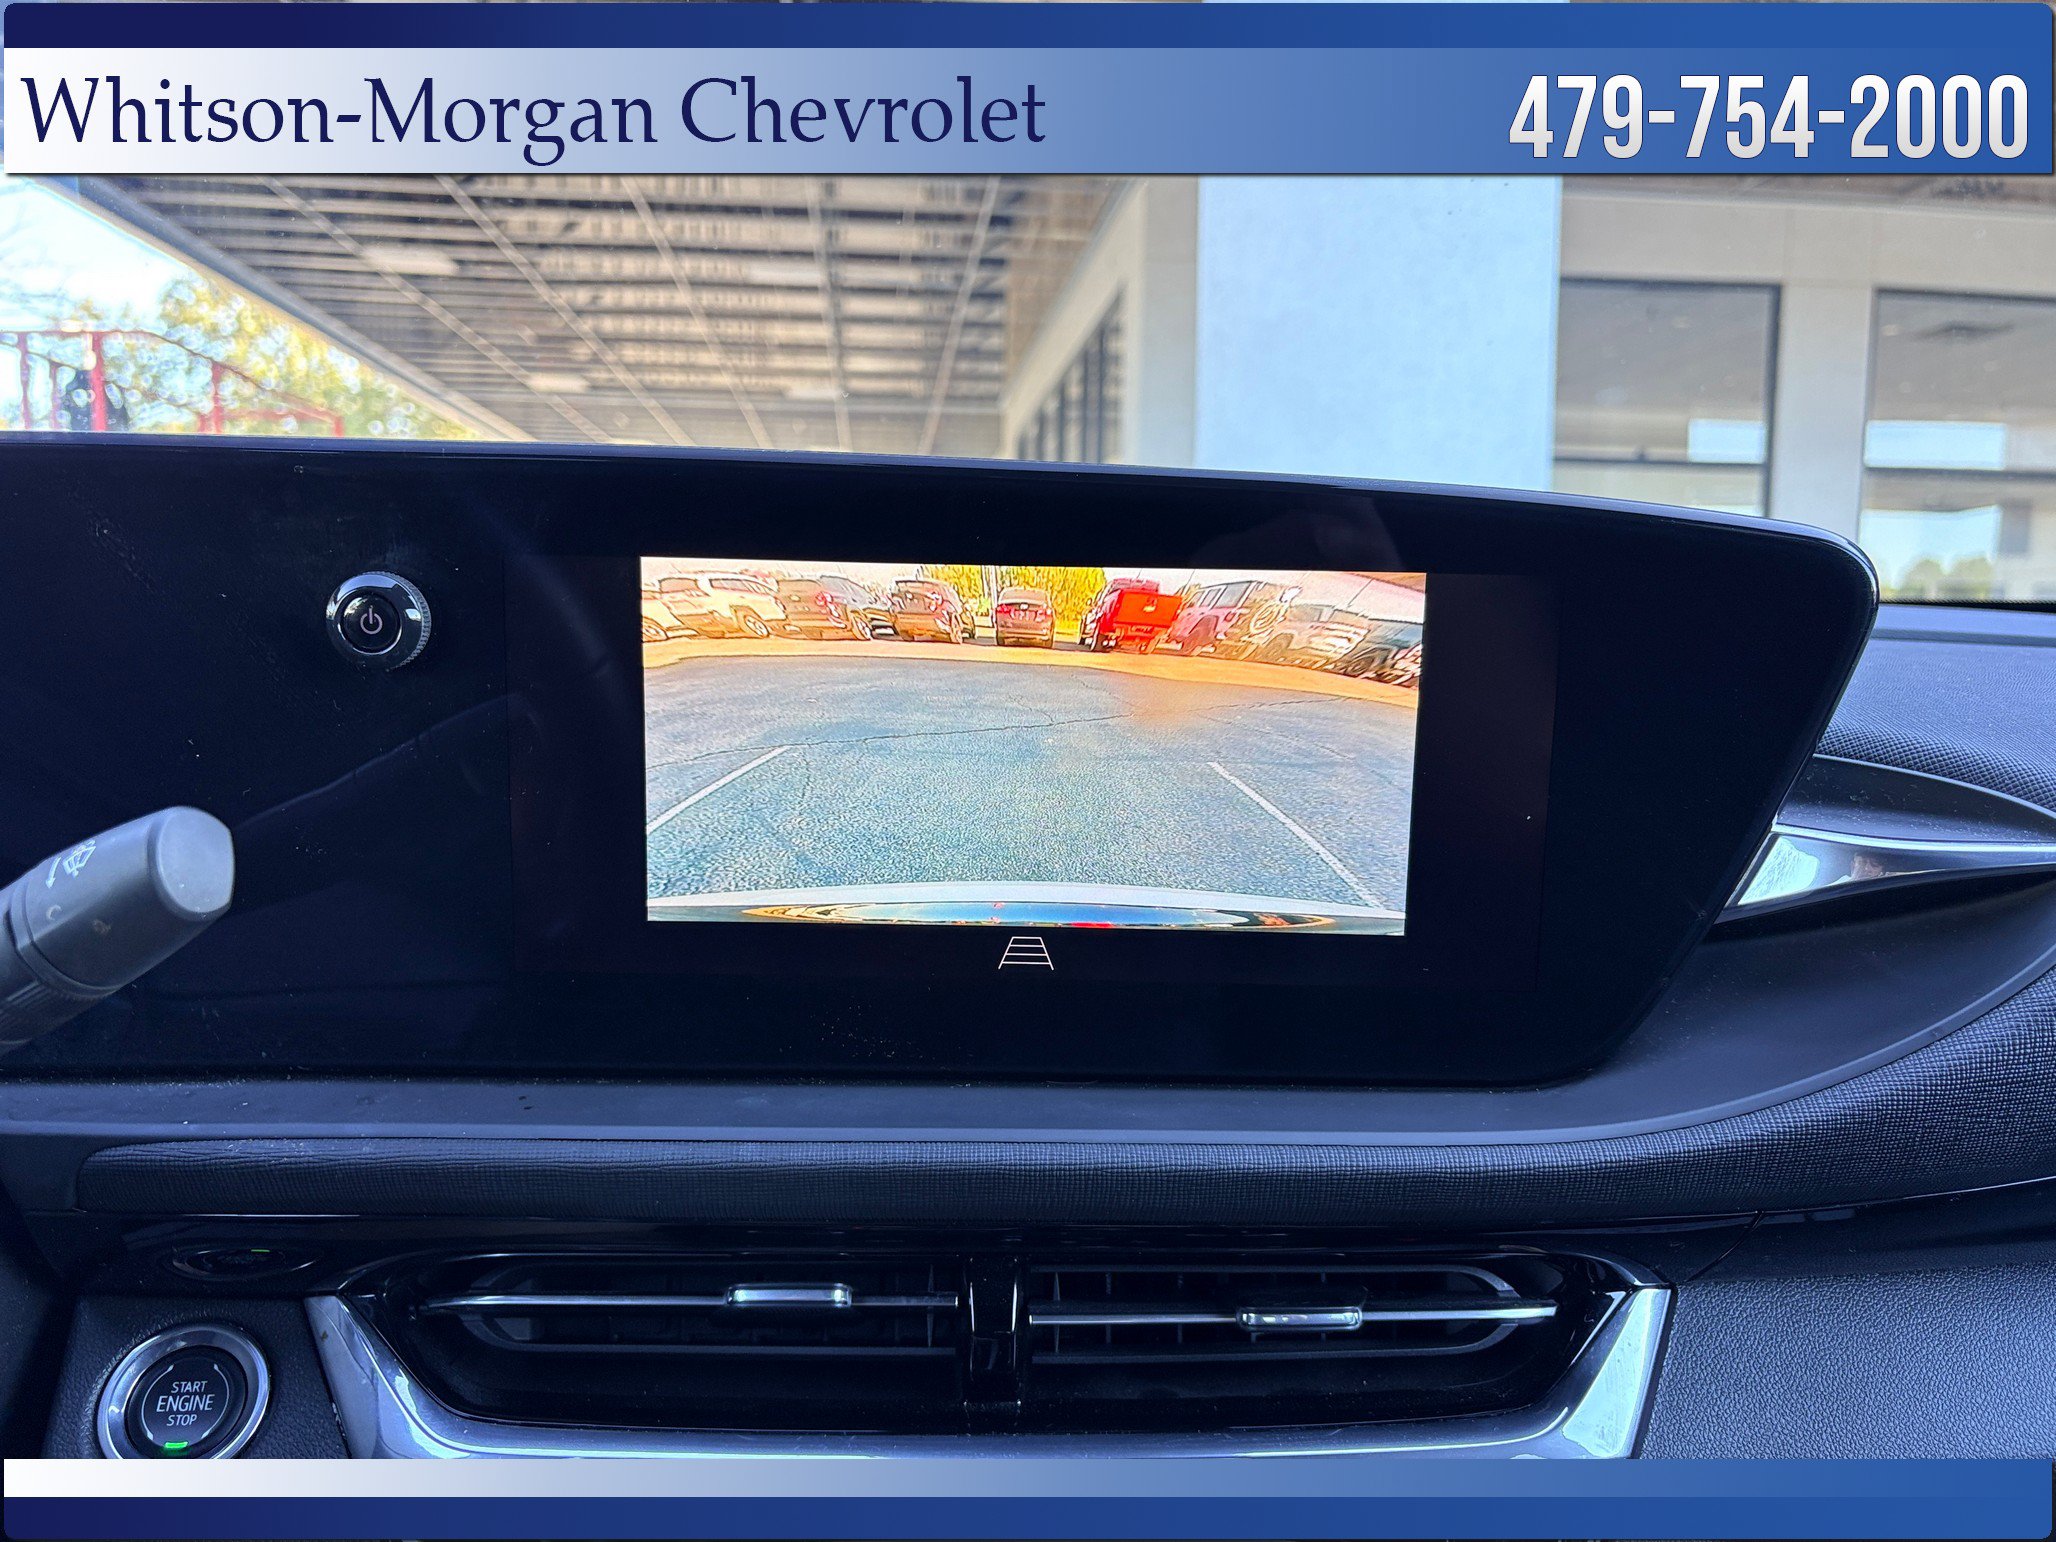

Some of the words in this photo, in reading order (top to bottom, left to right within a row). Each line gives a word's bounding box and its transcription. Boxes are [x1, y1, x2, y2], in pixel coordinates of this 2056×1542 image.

[171, 1380, 208, 1394] START
[156, 1394, 215, 1412] ENGINE
[166, 1414, 198, 1427] STOP
